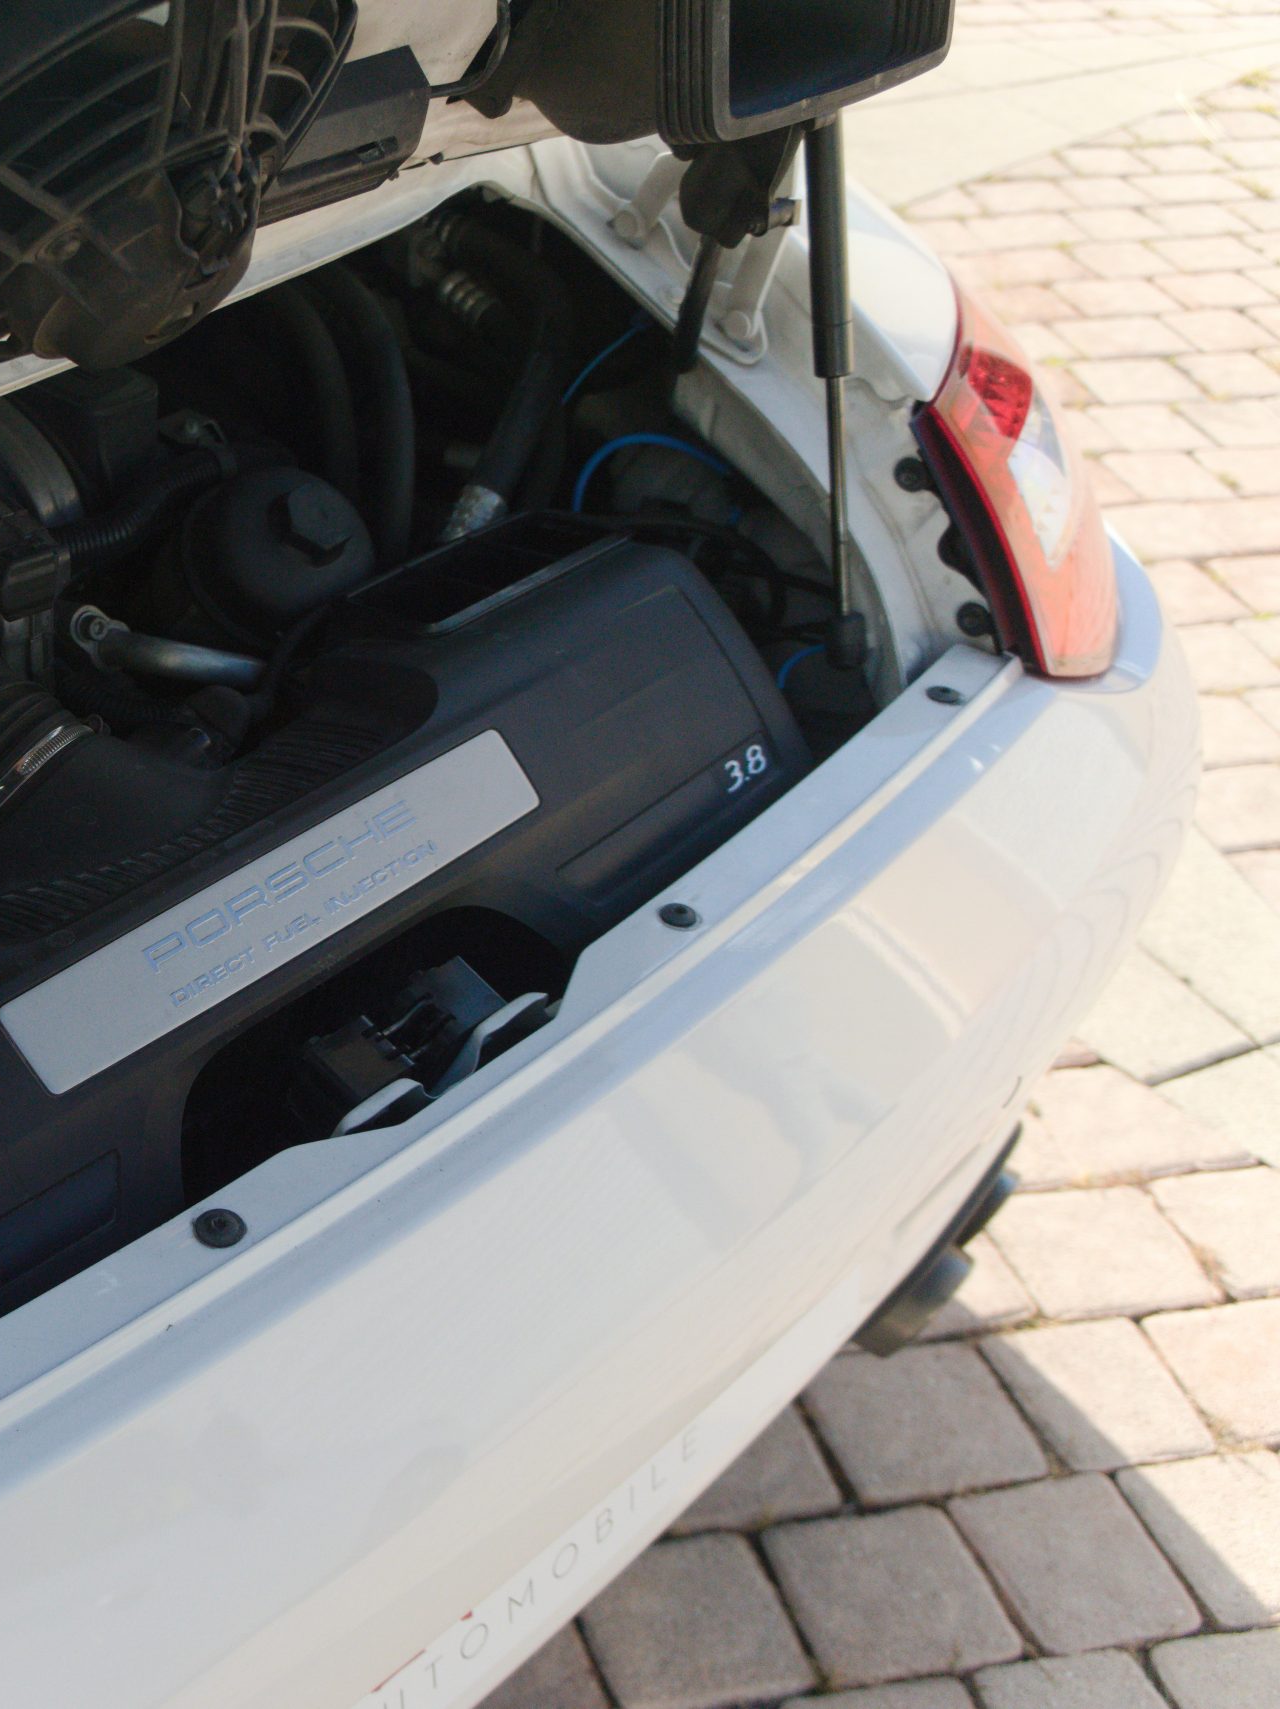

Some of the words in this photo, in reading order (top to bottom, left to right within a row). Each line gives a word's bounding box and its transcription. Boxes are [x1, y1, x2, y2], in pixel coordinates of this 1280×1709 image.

[724, 744, 766, 793] 3.8
[141, 799, 417, 974] PORSCHE
[169, 947, 256, 1008] DIRECT
[261, 912, 324, 952] FUEL
[323, 839, 440, 914] INJECTION
